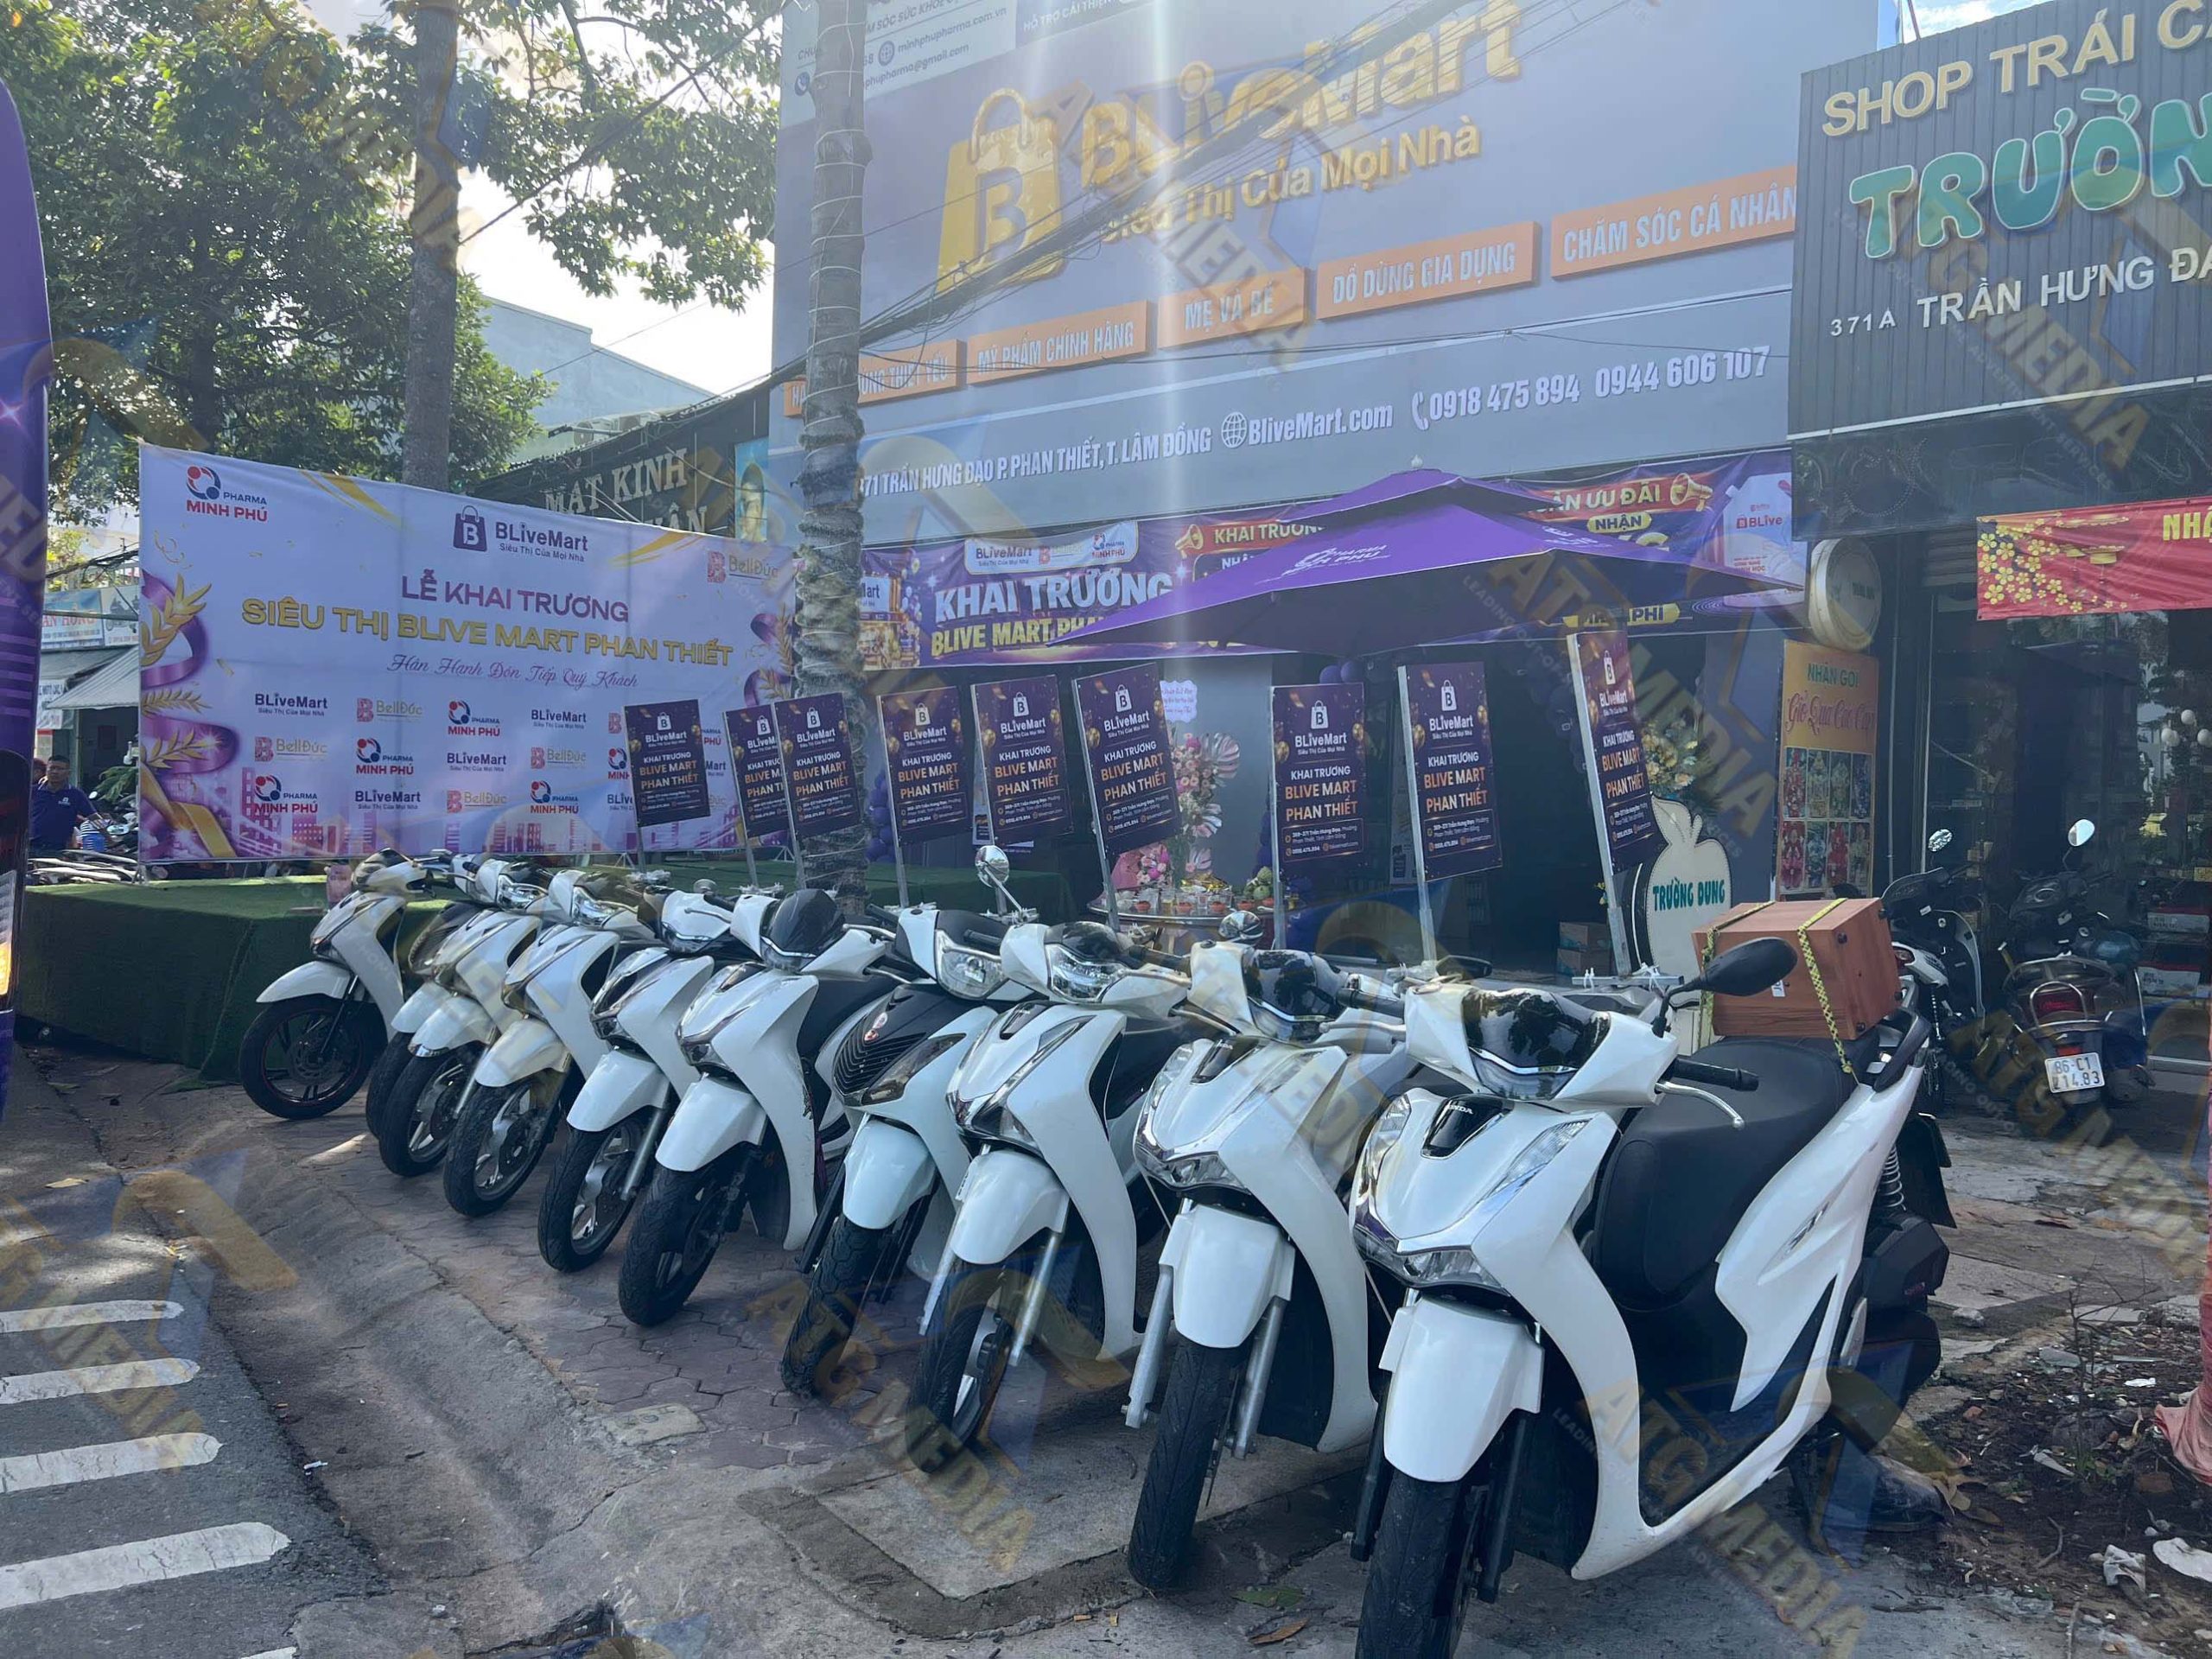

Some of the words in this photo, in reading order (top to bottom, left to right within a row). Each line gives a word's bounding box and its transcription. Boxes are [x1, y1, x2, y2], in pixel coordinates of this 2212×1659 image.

[898, 7, 1007, 54] minhphupharma.com.vn
[865, 43, 969, 90] phupharma@gmail.com
[1821, 60, 1974, 138] SHOP
[1989, 7, 2137, 93] TRÁI
[1241, 154, 1312, 207] Của
[1320, 137, 1391, 191] Mọi
[1398, 116, 1482, 174] Nhà
[1849, 87, 2212, 260] TRƯỜN
[1563, 218, 1628, 263] CHĂM
[1636, 205, 1682, 250] SÓC
[1689, 197, 1722, 239] CÁ
[1730, 181, 1797, 232] NHÂN
[1333, 263, 1357, 307] ĐỒ
[1363, 256, 1414, 300] DÙNG
[1421, 254, 1453, 289] GIA
[1460, 242, 1516, 285] DỤNG
[1830, 307, 1896, 337] 371A
[1916, 276, 2022, 328] TRẦN
[2041, 255, 2155, 308] HƯNG
[1185, 300, 1213, 335] MẸ
[1219, 288, 1242, 323] VÀ
[1002, 331, 1040, 370] PHẨM
[1046, 326, 1089, 362] CHÍNH
[1430, 385, 1481, 422] 0918
[1487, 380, 1529, 415] 475
[1535, 373, 1580, 408] 894
[1596, 363, 1659, 398] 0944
[1667, 354, 1716, 388] 606
[1723, 345, 1771, 381] 107
[1249, 400, 1393, 447] BliveMart.com
[882, 462, 920, 494] TRẦN
[922, 465, 963, 491] HƯNG
[963, 459, 995, 488] ĐẠO
[1010, 451, 1053, 478] PHAN
[1121, 432, 1160, 465] LÂM
[1163, 422, 1211, 458] ĐỒNG
[223, 491, 268, 505] PHARMA
[187, 499, 230, 518] MINH
[234, 505, 268, 523] PHÚ
[1595, 514, 1643, 531] NHẬN
[1749, 515, 1783, 528] BLive
[495, 521, 589, 552] BLiveMart
[1215, 525, 1255, 544] KHAI
[499, 543, 518, 554] Siêu
[520, 546, 534, 557] Thị
[535, 547, 551, 558] Của
[553, 550, 567, 562] Mọi
[568, 551, 585, 563] Nhà
[976, 546, 1033, 561] BLiveMart
[402, 569, 438, 601] LỄ
[445, 581, 512, 610] KHAI
[518, 589, 629, 623] TRƯƠNG
[934, 579, 1020, 626] KHAI
[1023, 566, 1173, 612] TRƯƠNG
[242, 596, 325, 629] SIÊU
[333, 607, 389, 641] THỊ
[397, 612, 486, 645] BLIVE
[494, 623, 579, 652] MART
[584, 632, 658, 661] PHAN
[664, 638, 734, 667] THIẾT
[931, 624, 988, 658] BLIVE
[992, 616, 1053, 648] MART
[255, 692, 328, 709] BLiveMart
[376, 699, 423, 715] BellĐức
[531, 709, 587, 723] BLiveMart
[1001, 717, 1046, 734] BLiveMart
[1103, 710, 1150, 732] BLiveMart
[1429, 715, 1473, 732] BLiveMart
[448, 726, 476, 736] MINH
[478, 726, 501, 737] PHÚ
[1295, 731, 1347, 748] BLiveMart
[276, 738, 328, 754] BellĐức
[999, 750, 1020, 761] KHAI
[1020, 745, 1052, 759] TRƯƠNG
[1103, 749, 1124, 763] KHAI
[1124, 741, 1157, 757] TRƯƠNG
[356, 765, 387, 775] MINH
[390, 763, 414, 775] PHÚ
[448, 752, 507, 766] BLiveMart
[995, 762, 1027, 779] BLIVE
[1027, 756, 1058, 773] MART
[1101, 763, 1131, 782] BLIVE
[1134, 752, 1165, 772] MART
[1427, 755, 1447, 767] KHAI
[1447, 751, 1479, 766] TRƯƠNG
[997, 779, 1030, 797] PHAN
[1032, 769, 1060, 792] THIẾT
[1104, 782, 1137, 802] PHAN
[1139, 767, 1167, 791] THIẾT
[1291, 770, 1313, 781] KHAI
[1314, 766, 1351, 779] TRƯƠNG
[1424, 772, 1454, 789] BLIVE
[1456, 766, 1485, 783] MART
[355, 790, 421, 803] BLiveMart
[1285, 784, 1320, 800] BLIVE
[1322, 779, 1357, 796] MART
[1427, 793, 1457, 813] PHAN
[1459, 785, 1488, 808] THIẾT
[254, 803, 288, 814] MINH
[291, 800, 318, 813] PHÚ
[531, 804, 556, 814] MINH
[558, 804, 579, 814] PHÚ
[1286, 804, 1322, 822] PHAN
[1325, 796, 1358, 817] THIẾT
[1652, 876, 1694, 912] TRƯỜNG
[1698, 880, 1726, 907] DUNG
[2055, 1057, 2091, 1074] 86-C1
